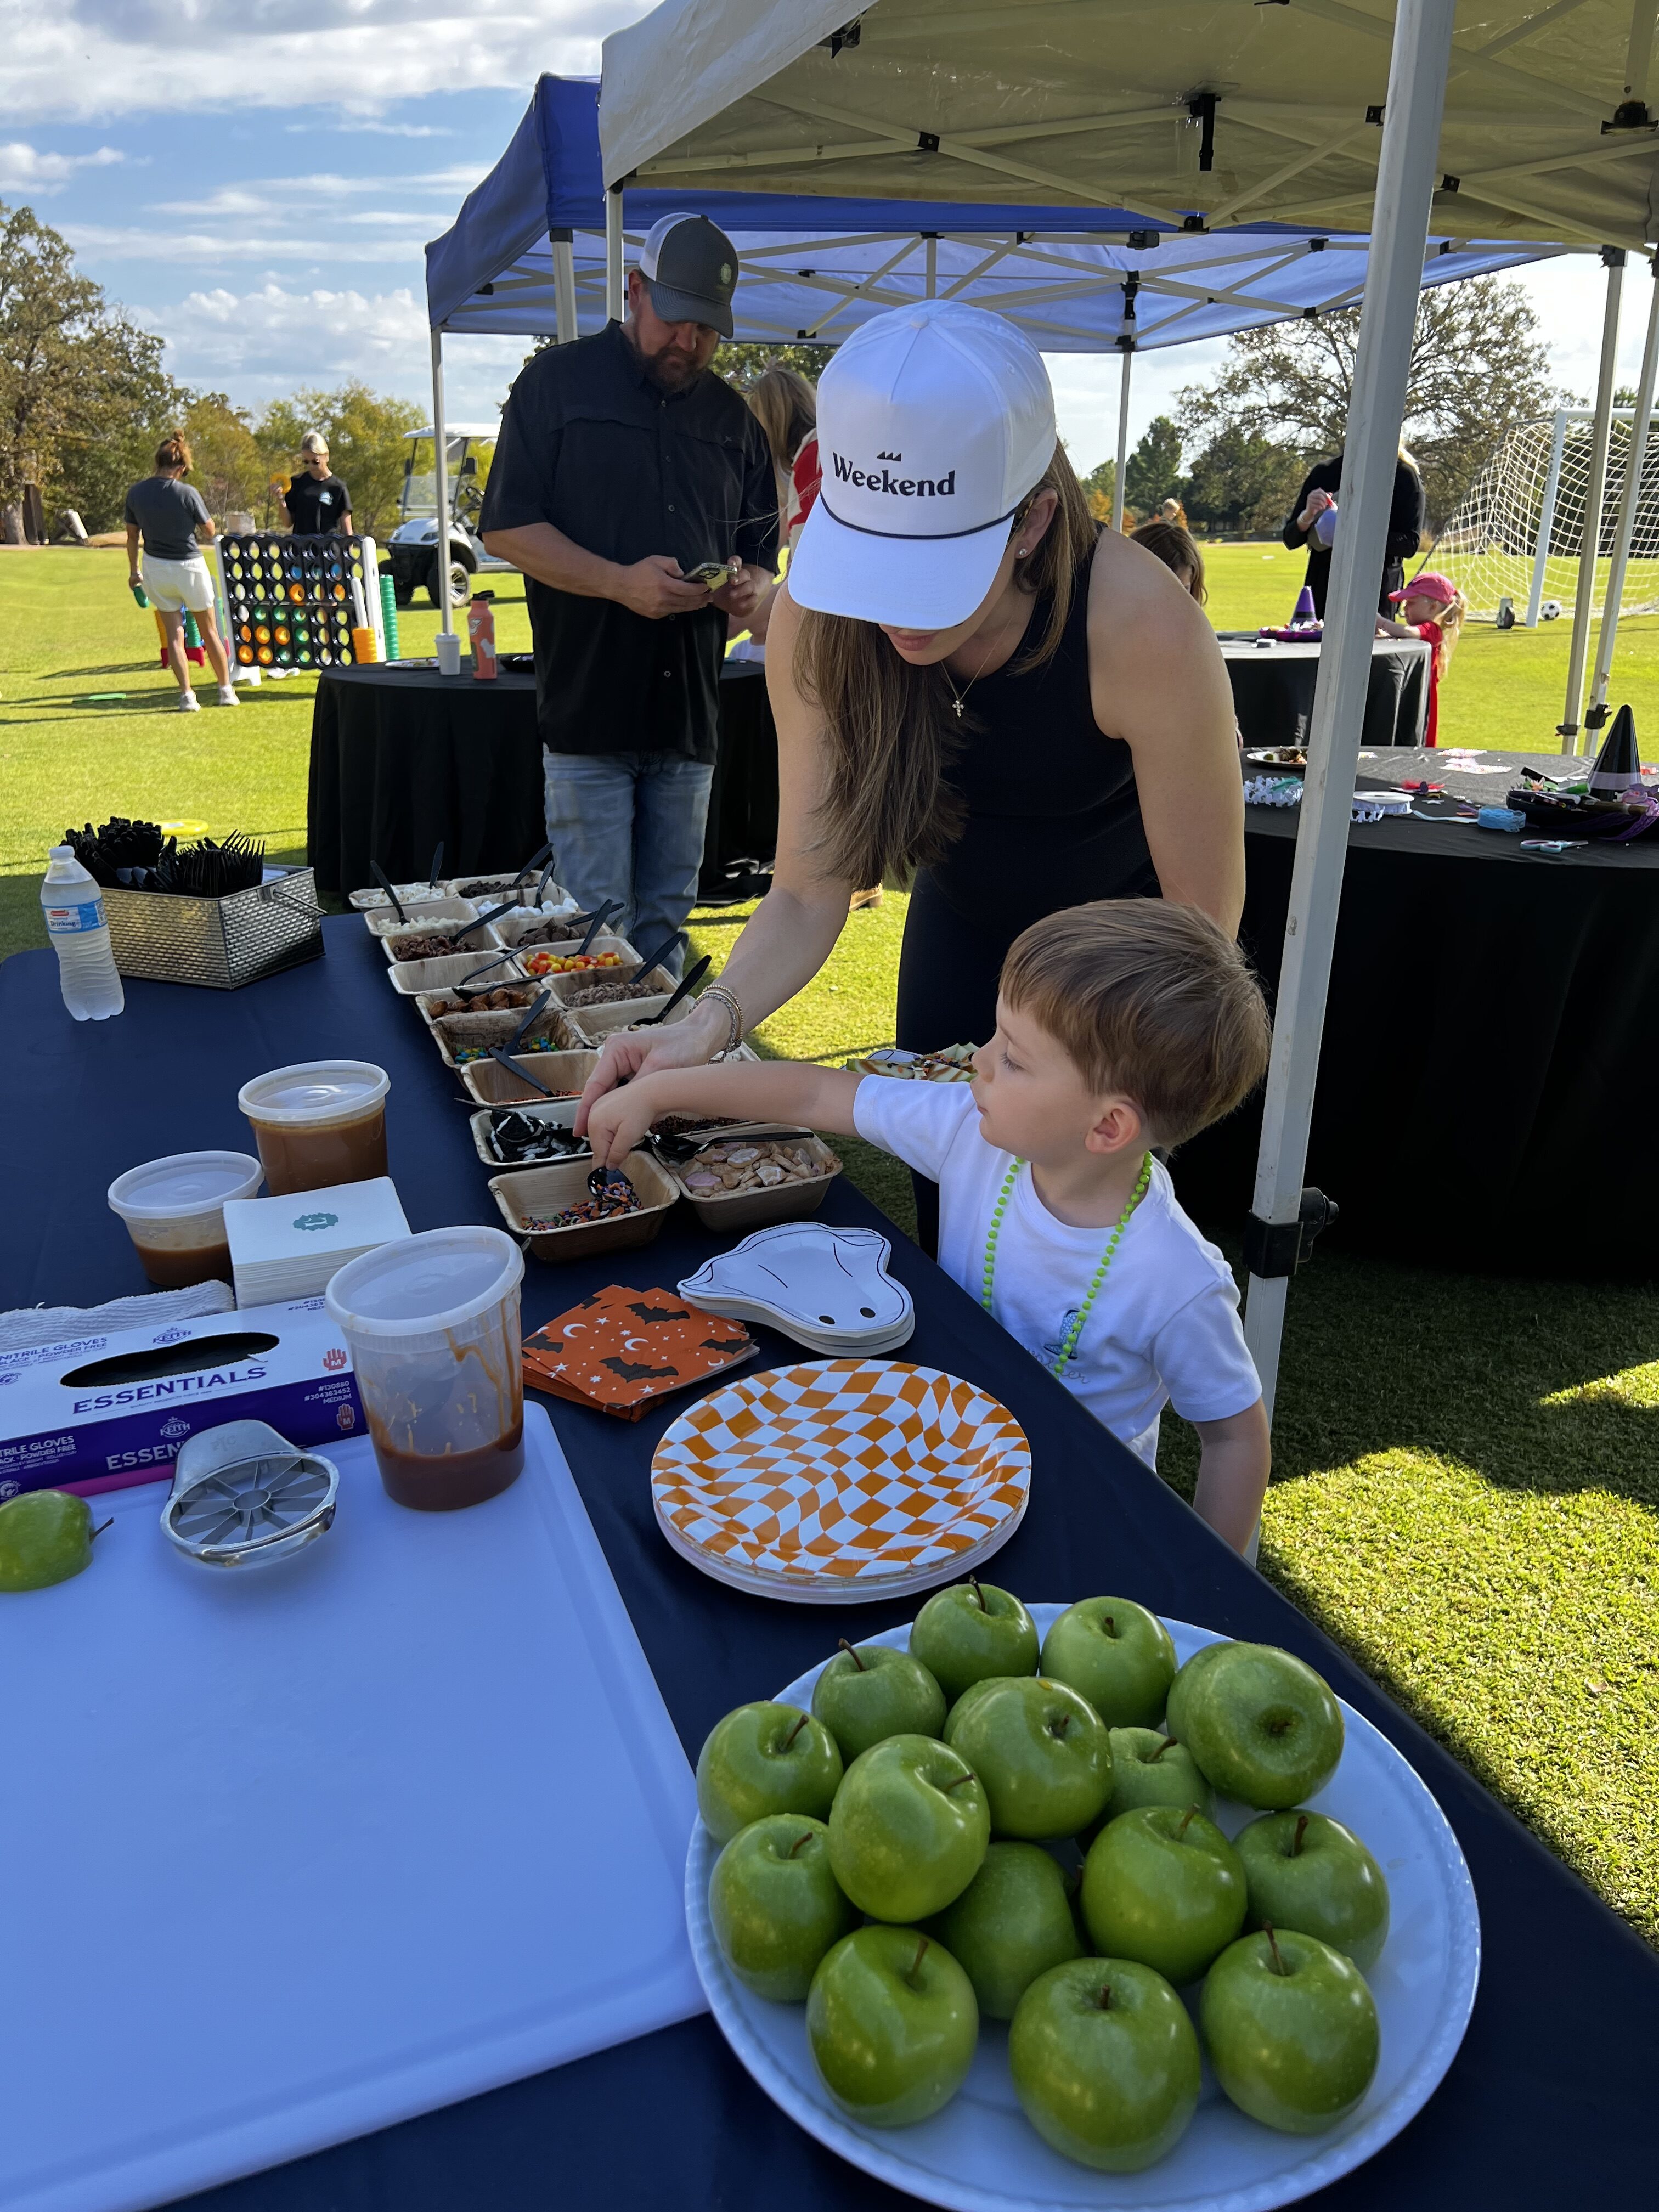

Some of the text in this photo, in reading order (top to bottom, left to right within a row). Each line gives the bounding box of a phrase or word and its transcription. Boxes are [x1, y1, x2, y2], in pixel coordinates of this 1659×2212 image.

[833, 452, 955, 496] Weekend
[153, 1331, 192, 1343] KEITH
[0, 1337, 108, 1361] NITRILE GLOVES
[38, 1347, 82, 1358] POWDER
[73, 1367, 267, 1414] ESSENTIALS
[318, 1380, 350, 1392] #130880
[323, 1393, 352, 1404] MEDIUM
[343, 1417, 351, 1425] M
[159, 1423, 191, 1436] KEITH
[0, 1435, 75, 1458] TRILE GLOVES
[20, 1448, 56, 1460] POWDER
[57, 1444, 77, 1453] FREE
[106, 1441, 184, 1470] ESSEN
